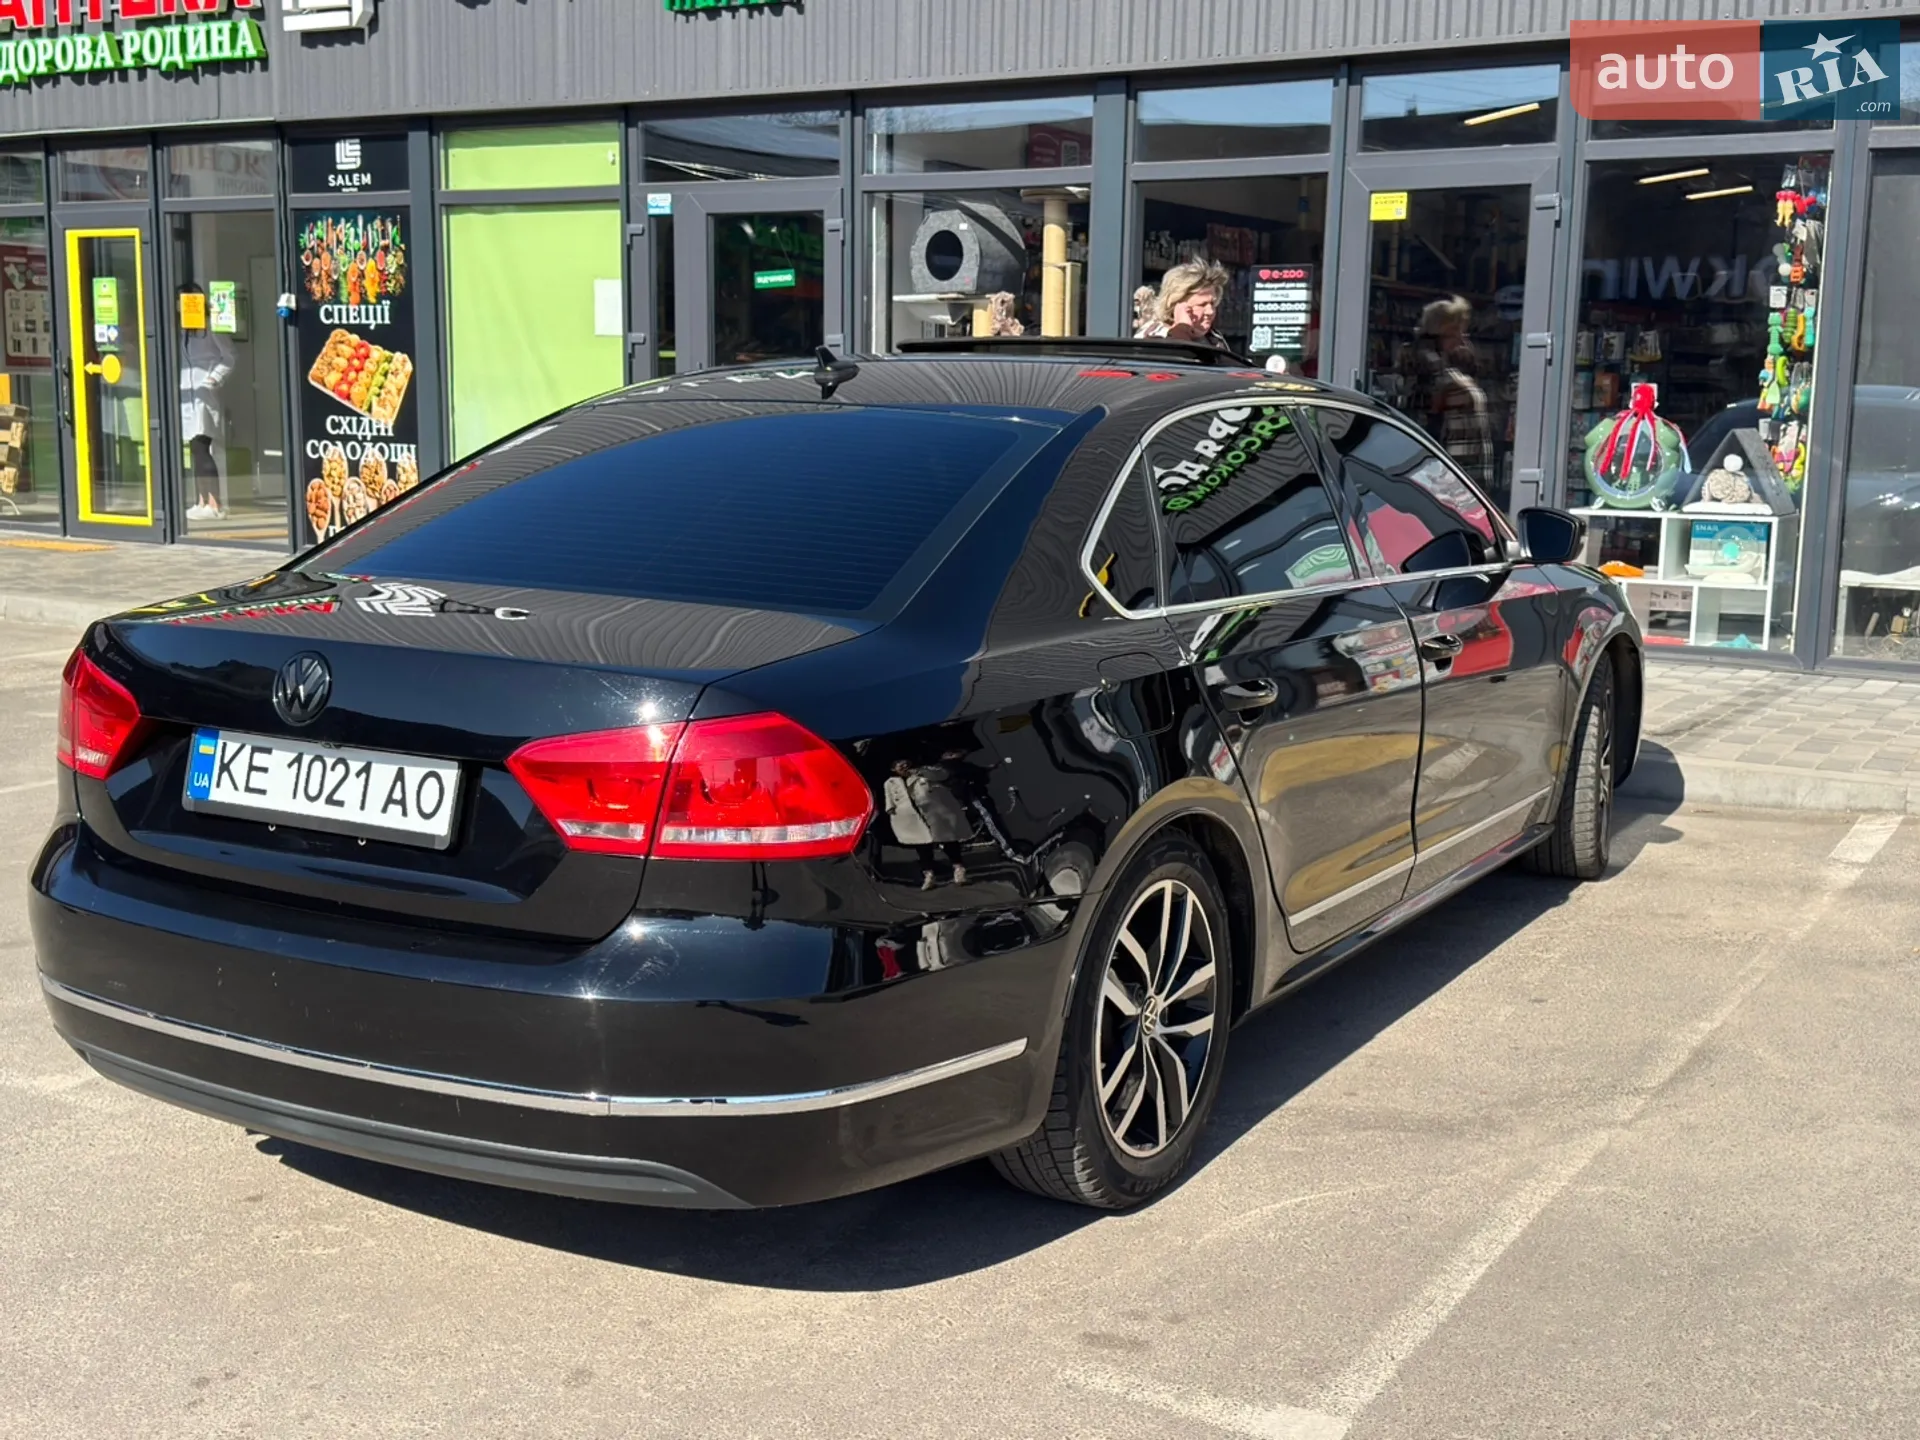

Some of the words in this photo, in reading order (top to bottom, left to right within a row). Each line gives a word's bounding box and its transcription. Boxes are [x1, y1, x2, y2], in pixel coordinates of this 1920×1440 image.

[122, 19, 258, 71] РОДИНА
[328, 173, 372, 187] SALEM
[319, 300, 391, 329] СПЕЦІЇ
[325, 415, 395, 440] СХІДНІ
[193, 771, 209, 788] UA
[216, 741, 274, 796] KE
[287, 752, 373, 811] 1021
[381, 765, 445, 820] AO
